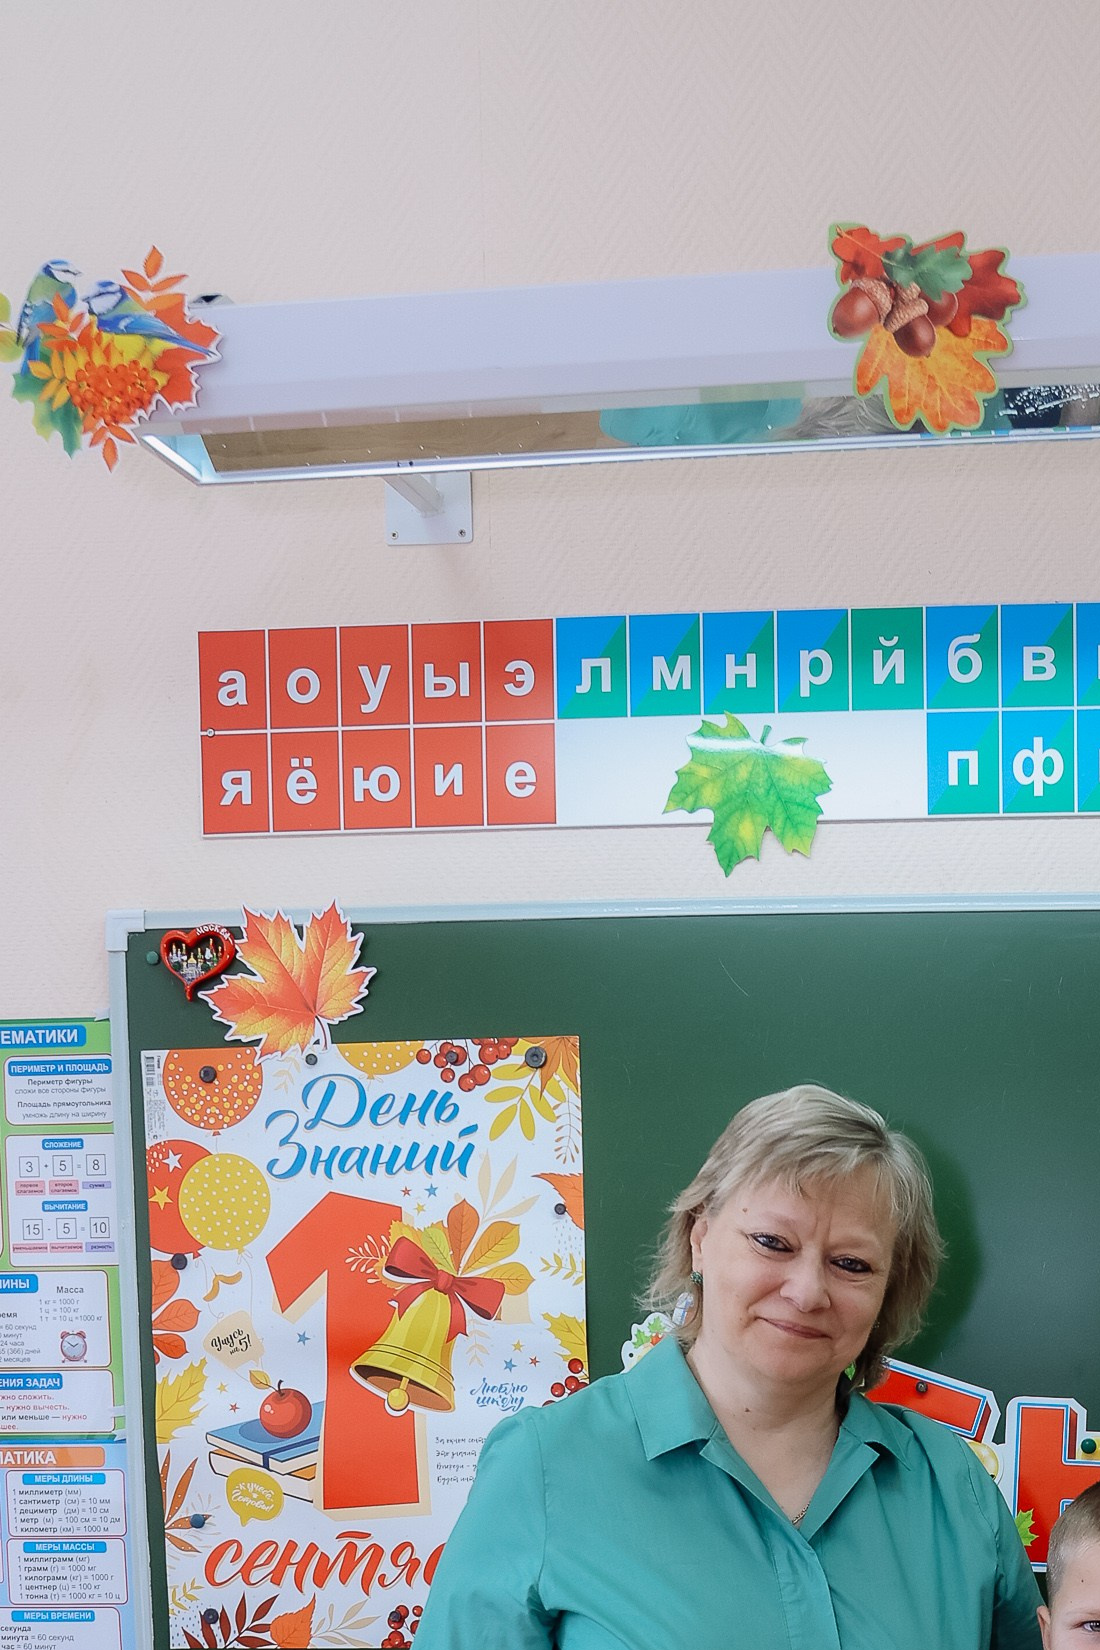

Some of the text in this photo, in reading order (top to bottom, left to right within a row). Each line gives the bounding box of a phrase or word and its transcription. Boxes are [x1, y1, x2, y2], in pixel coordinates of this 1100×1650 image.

[218, 669, 248, 706] а
[286, 669, 320, 703] о
[358, 662, 391, 710] у
[424, 662, 470, 699] ы
[504, 660, 536, 697] э
[576, 656, 612, 694] л
[653, 655, 692, 691] м
[726, 653, 756, 688] н
[800, 649, 834, 697] р
[874, 635, 906, 686] й
[948, 633, 982, 684] б
[1022, 644, 1057, 681] в
[220, 769, 252, 805] я
[286, 758, 318, 805] ё
[354, 765, 400, 803] ю
[435, 763, 463, 796] и
[505, 760, 537, 796] е
[949, 750, 978, 786] п
[1013, 737, 1065, 797] ф
[11, 1063, 109, 1073] ПЕРИМЕТР И ПЛОЩАДЬ
[27, 1078, 93, 1087] Периметр фигуры
[81, 1086, 106, 1095] фигуры
[53, 1100, 111, 1108] прямоугольника
[302, 1074, 459, 1130] День
[265, 1110, 478, 1180] Знаний
[25, 1159, 100, 1173] 3 5 8
[26, 1222, 107, 1235] 15 5 10
[56, 1286, 84, 1294] Масса
[26, 1379, 60, 1389] ЗАДАЧ
[470, 1377, 528, 1395] Люблю
[476, 1396, 525, 1412] школу
[62, 1413, 87, 1421] нужно
[34, 1475, 93, 1484] МЕРЫ ДЛИНЫ
[19, 1488, 82, 1497] миллиметр (мм)
[64, 1498, 80, 1506] (см)
[64, 1507, 80, 1515] (дм)
[60, 1526, 75, 1534] (км)
[36, 1543, 95, 1552] МЕРЫ МАССЫ
[23, 1612, 91, 1620] МЕРЫ ВРЕМЕНИ
